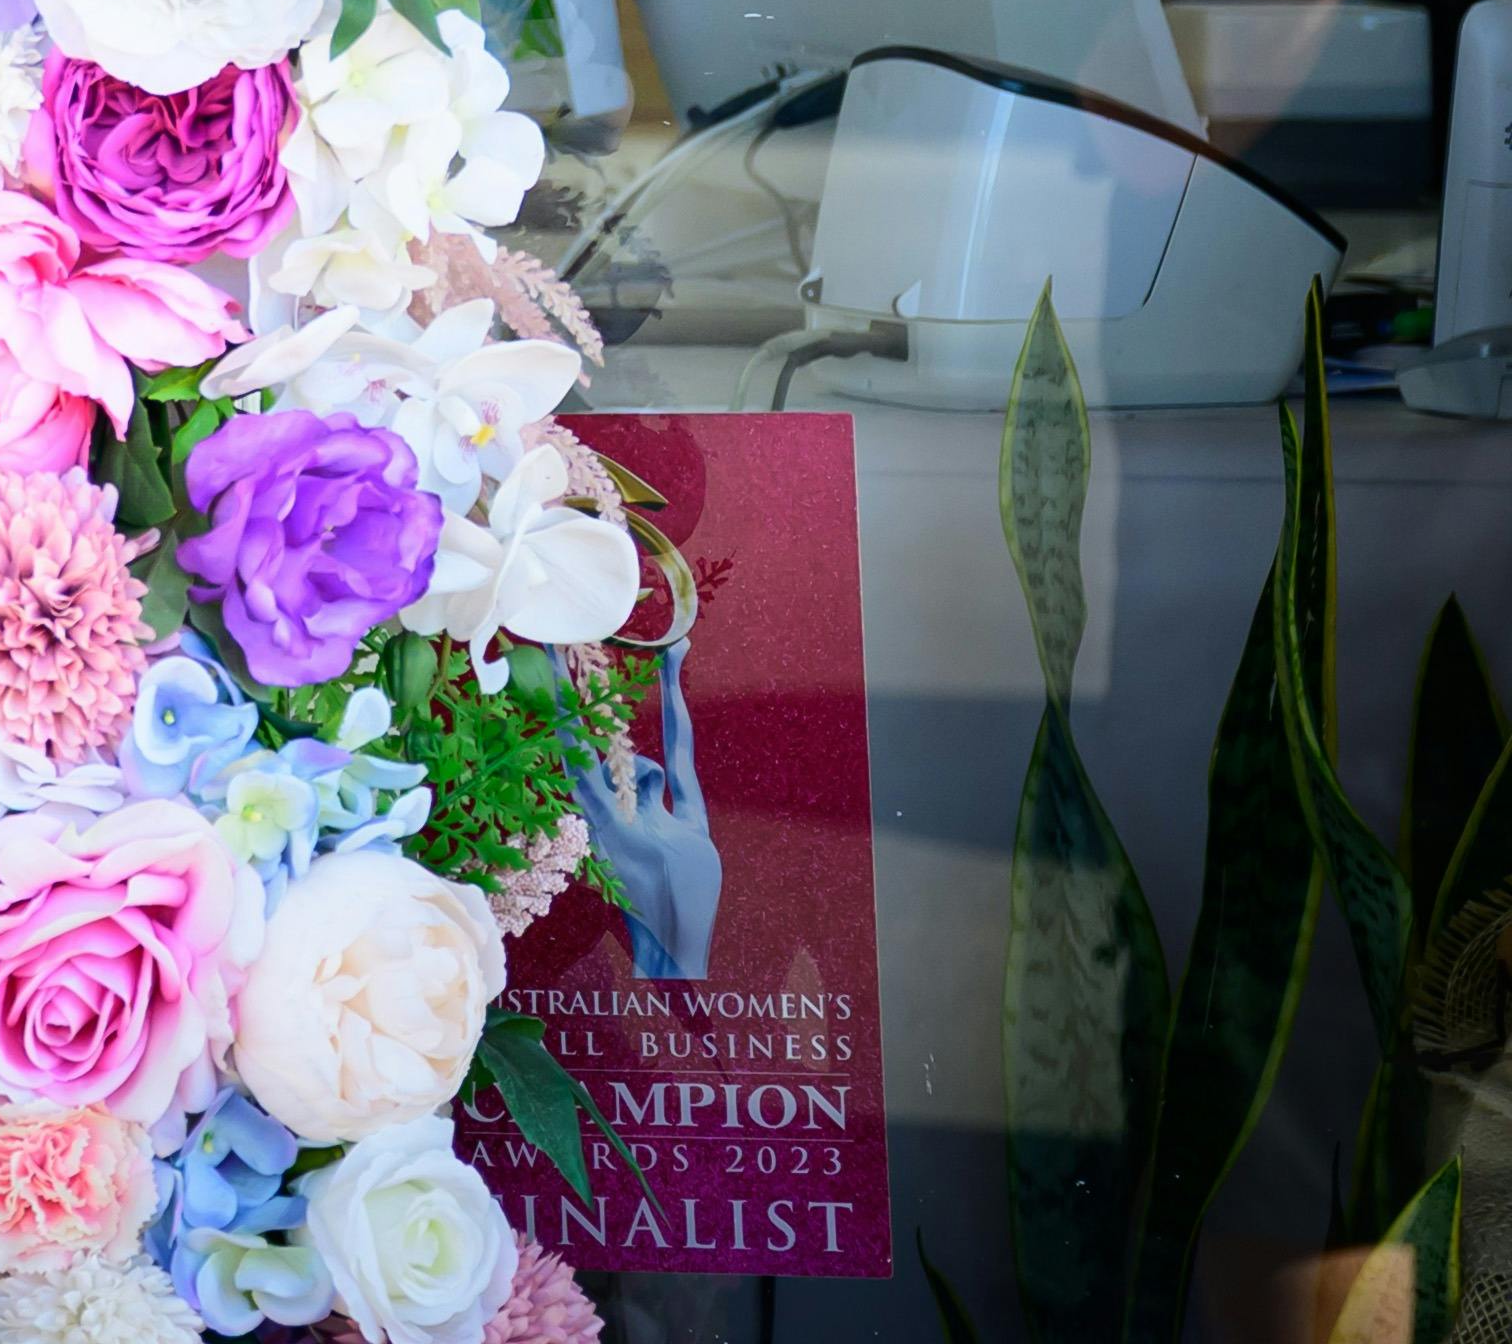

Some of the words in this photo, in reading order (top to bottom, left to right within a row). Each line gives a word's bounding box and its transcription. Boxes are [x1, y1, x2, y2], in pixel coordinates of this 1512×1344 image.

[497, 989, 671, 1016] STRALIAN
[641, 1032, 854, 1062] BUSINESS
[471, 1140, 690, 1172] AWRDS
[725, 1146, 842, 1175] 2023
[492, 1193, 854, 1254] INALIST
